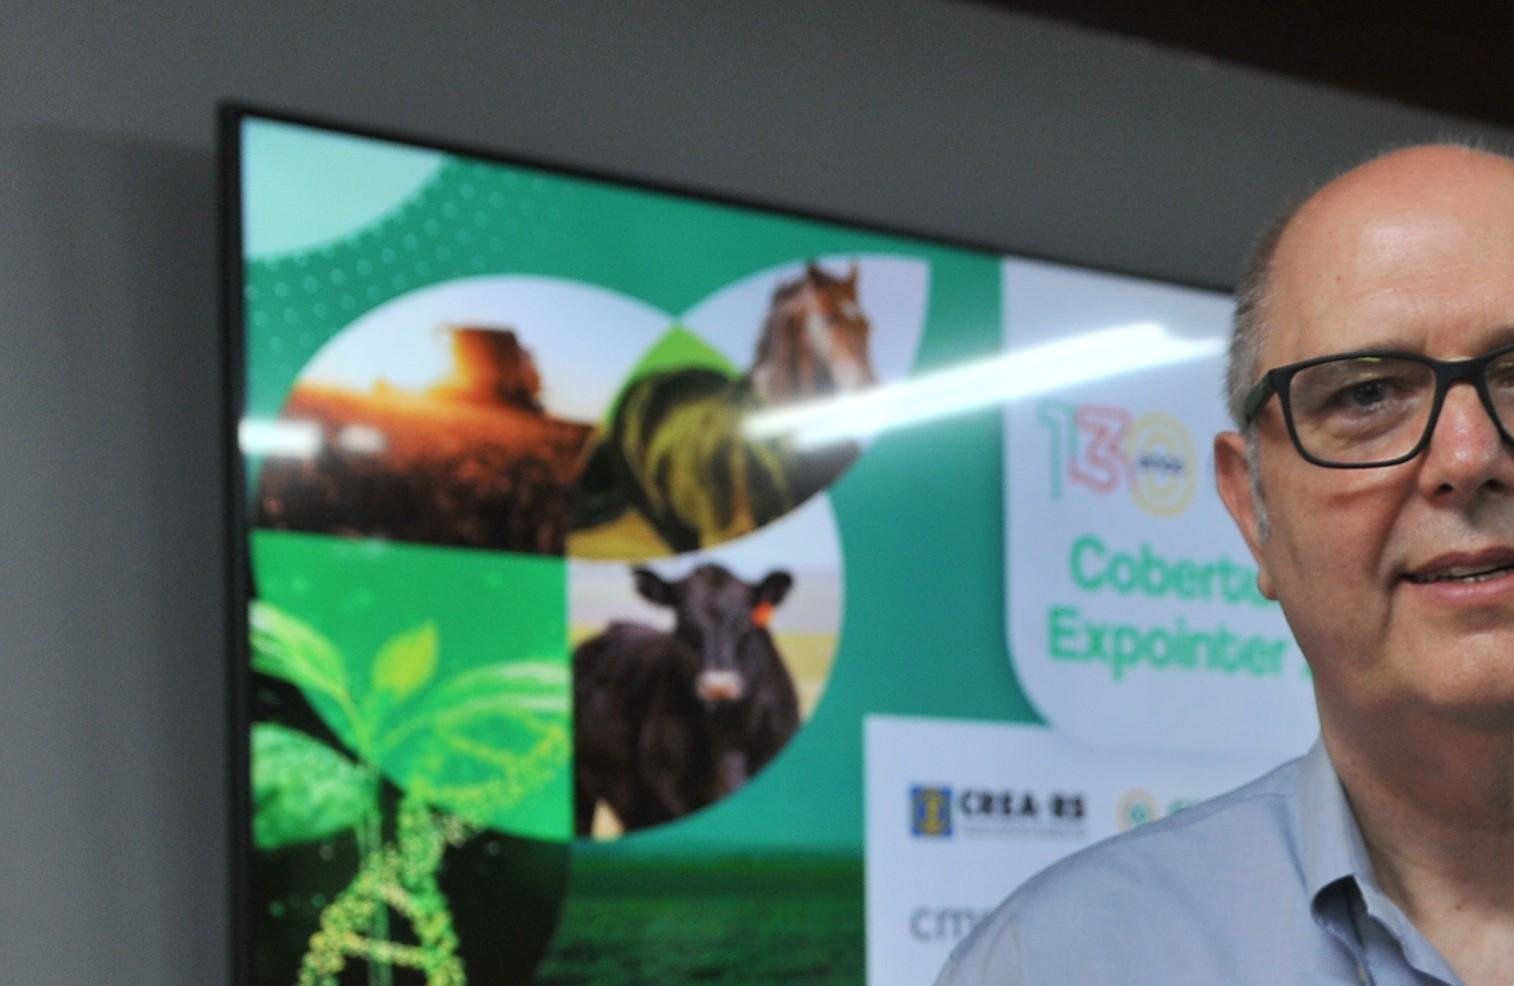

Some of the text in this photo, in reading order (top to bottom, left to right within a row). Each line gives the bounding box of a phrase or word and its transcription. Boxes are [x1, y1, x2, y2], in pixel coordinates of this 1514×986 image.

[1034, 398, 1197, 519] 130
[1069, 533, 1279, 606] Cobertu
[1047, 603, 1289, 681] Expointer
[959, 788, 1038, 818] CREA
